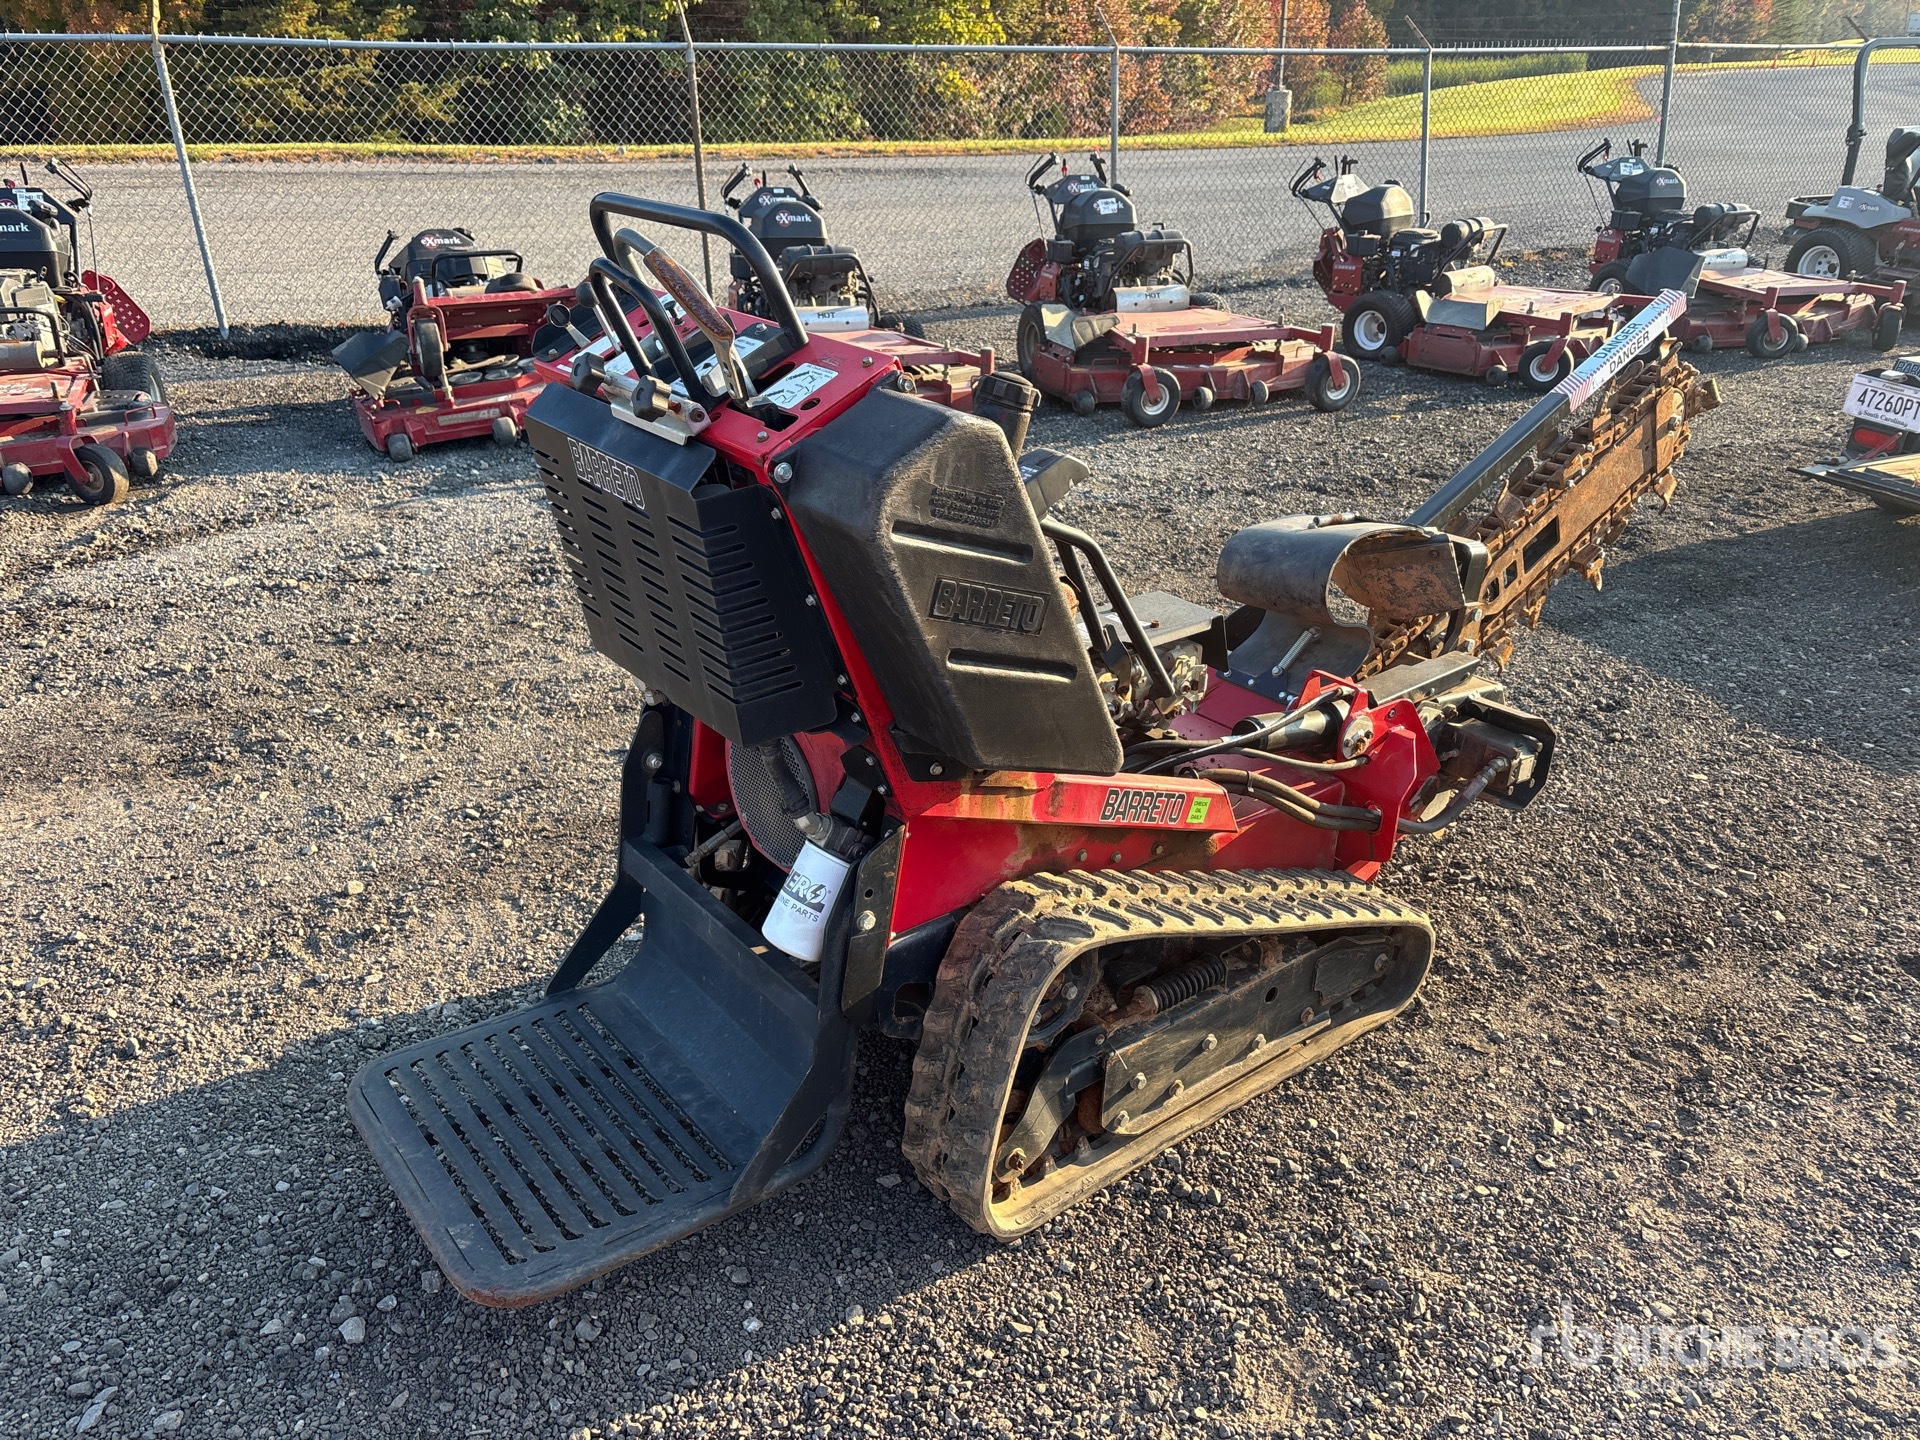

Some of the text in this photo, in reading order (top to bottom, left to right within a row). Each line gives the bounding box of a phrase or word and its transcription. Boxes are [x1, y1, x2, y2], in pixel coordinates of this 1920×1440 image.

[775, 213, 812, 224] eXmark
[420, 236, 462, 247] eXmark
[1594, 322, 1643, 359] DANGER
[1609, 331, 1650, 374] DANGER
[1863, 409, 1879, 419] South
[567, 436, 646, 510] BARRETO
[933, 579, 1045, 632] BARRETO
[1099, 787, 1187, 825] BARRETO
[790, 903, 820, 922] PARTS
